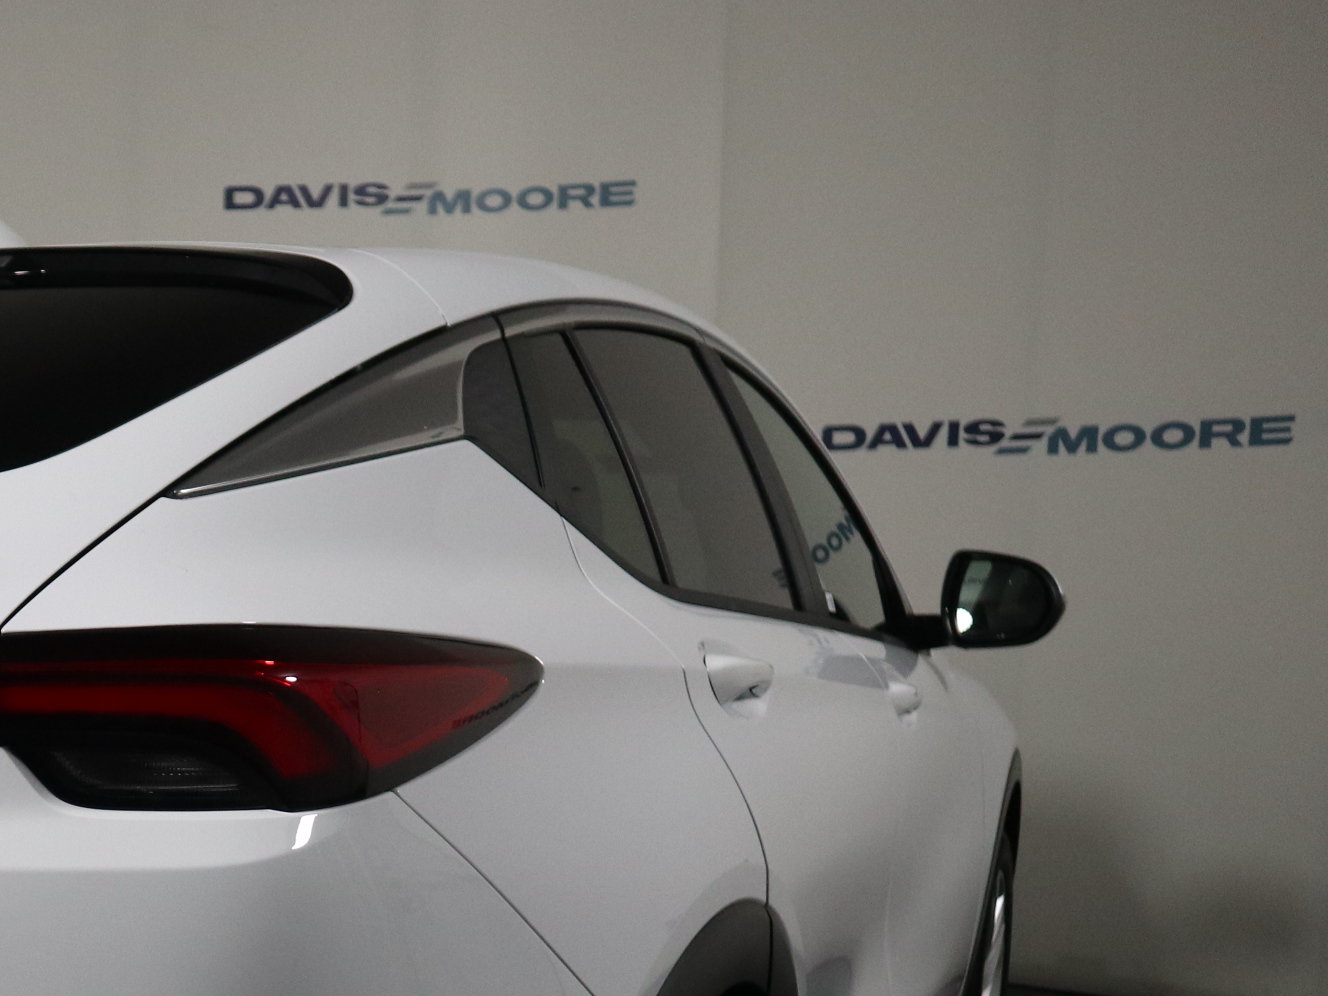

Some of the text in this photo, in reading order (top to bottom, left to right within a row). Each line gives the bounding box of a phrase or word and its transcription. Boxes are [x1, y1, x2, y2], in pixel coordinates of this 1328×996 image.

[223, 180, 637, 215] DAVIS MOORE
[822, 414, 1296, 456] DAVIS MOORE
